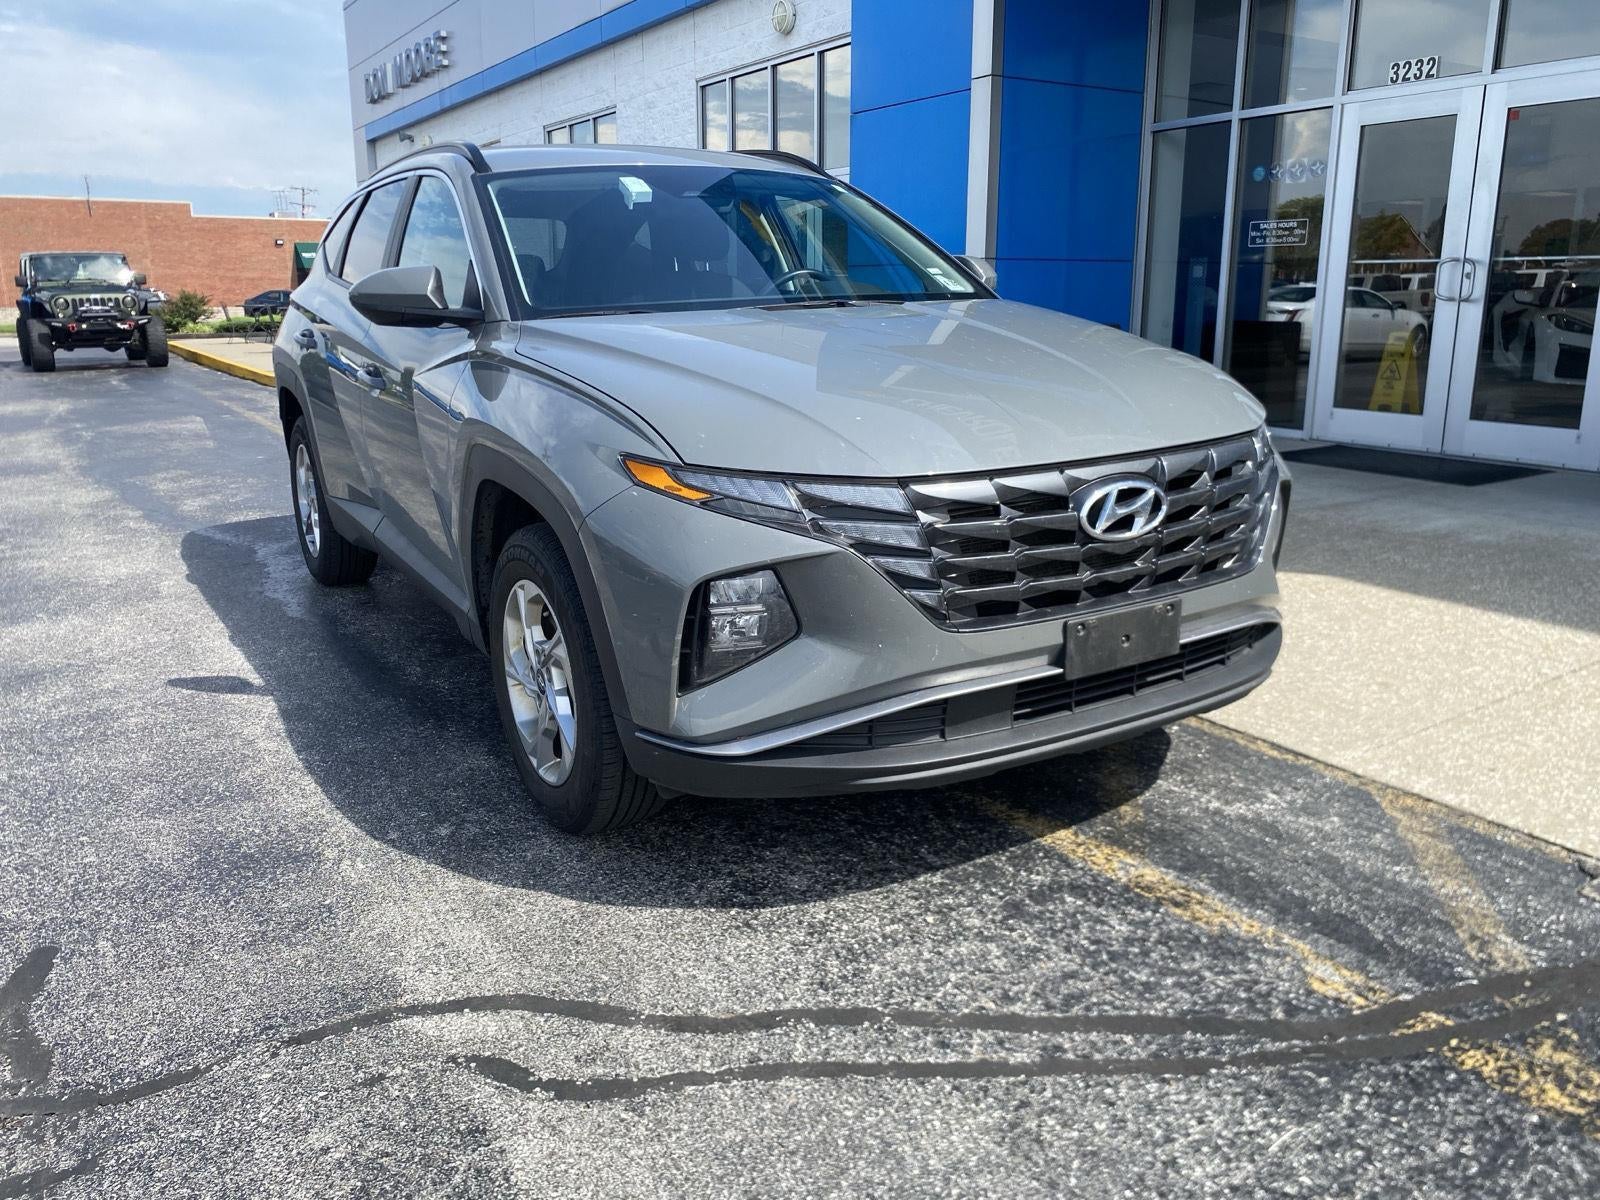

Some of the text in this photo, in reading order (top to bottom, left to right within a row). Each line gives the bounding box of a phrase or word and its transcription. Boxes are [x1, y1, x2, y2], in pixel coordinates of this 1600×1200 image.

[364, 30, 449, 104] DON MOORE
[1389, 56, 1437, 84] 3232
